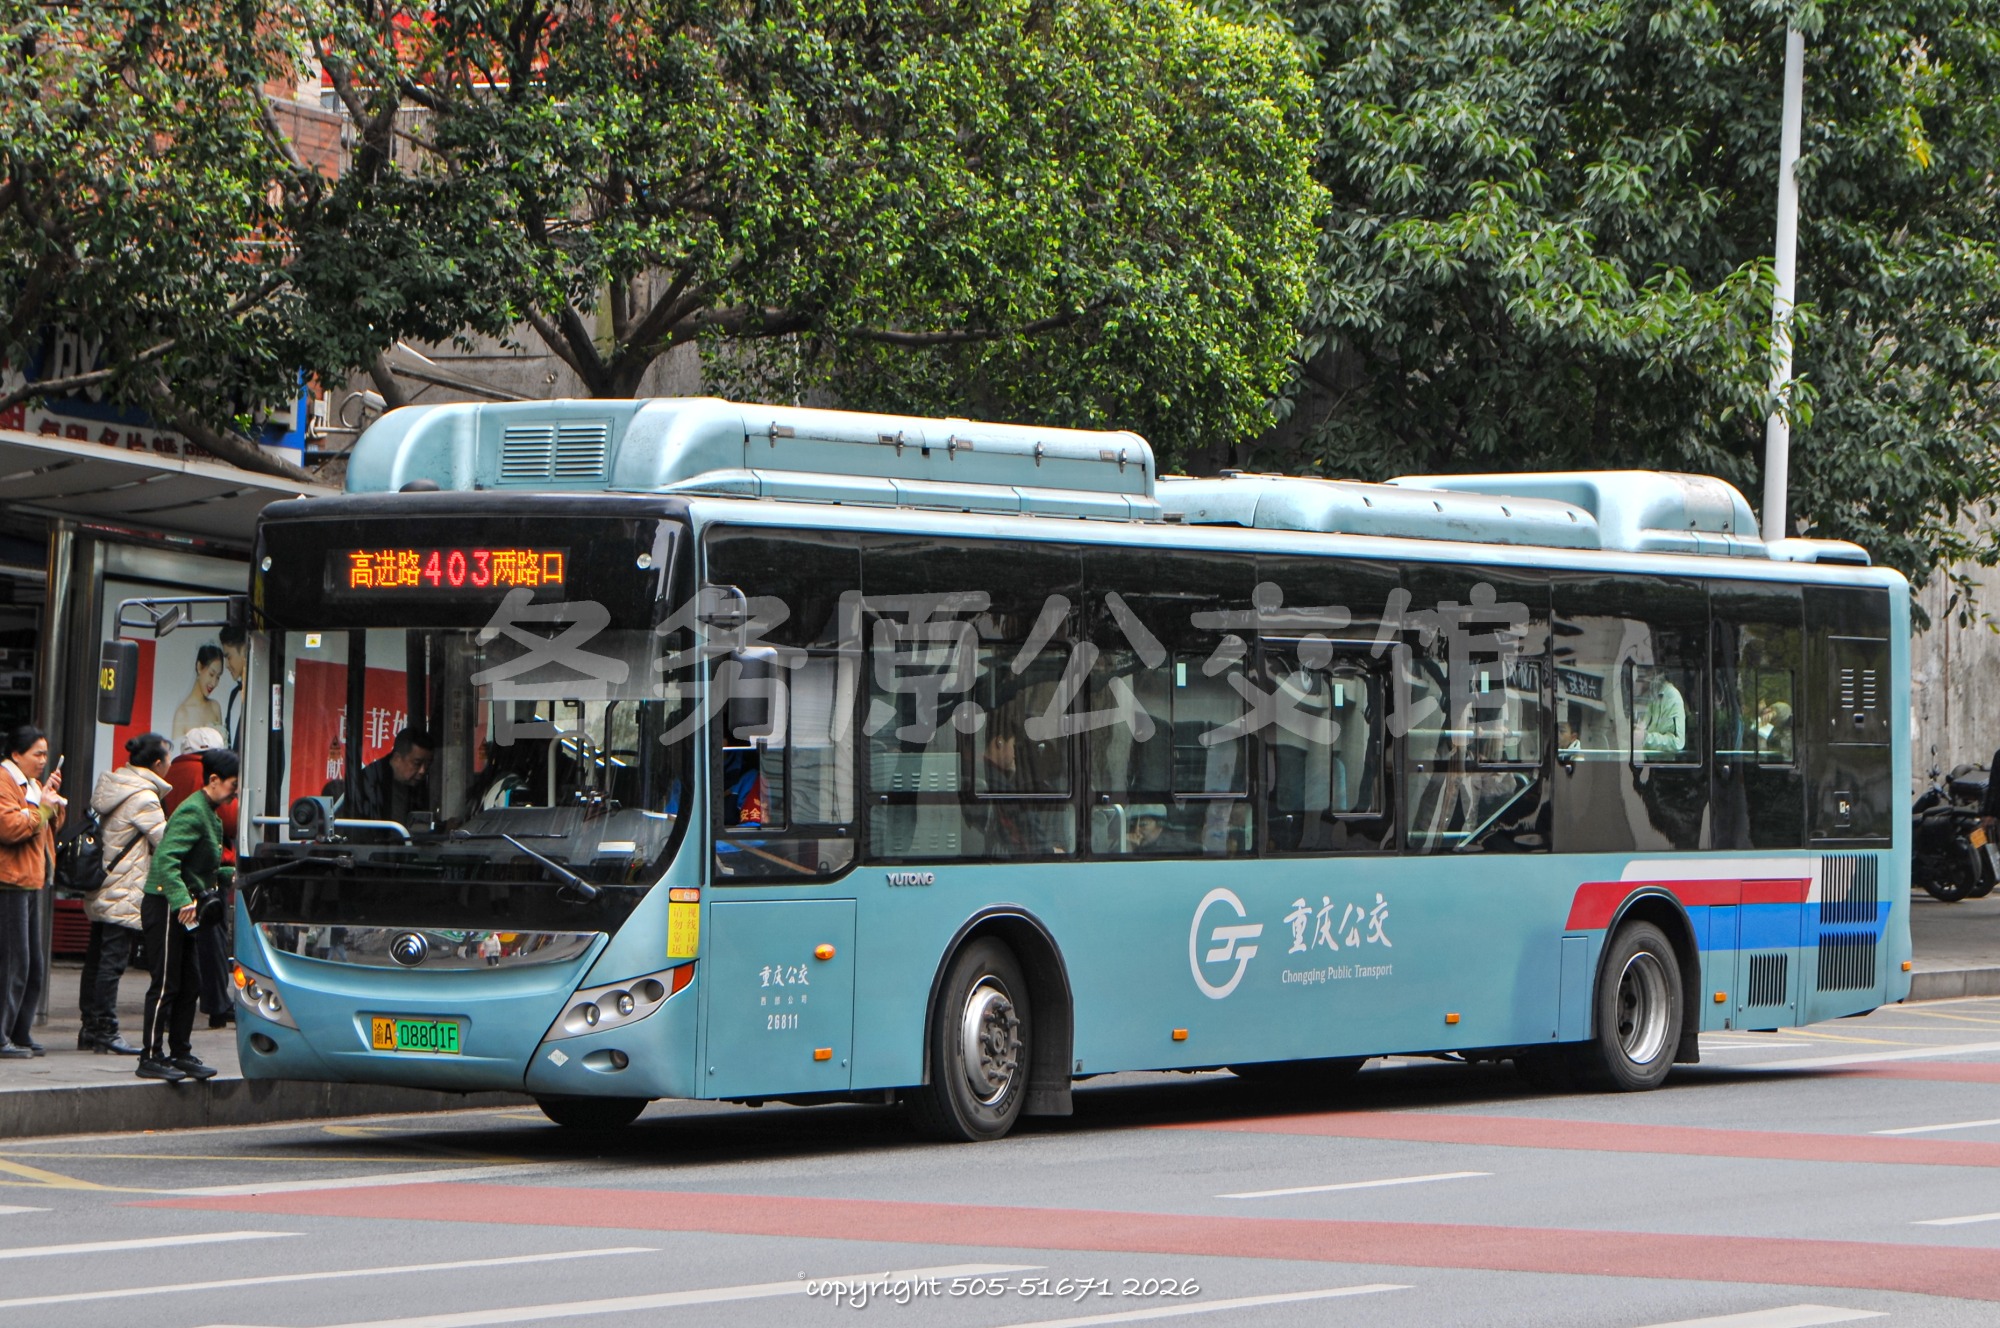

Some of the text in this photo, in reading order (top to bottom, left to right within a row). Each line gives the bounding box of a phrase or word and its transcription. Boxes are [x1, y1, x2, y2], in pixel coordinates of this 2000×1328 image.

[887, 872, 935, 887] YUTONG
[1283, 892, 1393, 954] 重庆公交
[759, 963, 810, 987] 重庆公交
[1281, 964, 1393, 985] Chongqing Public Transport
[767, 1013, 798, 1030] 26811
